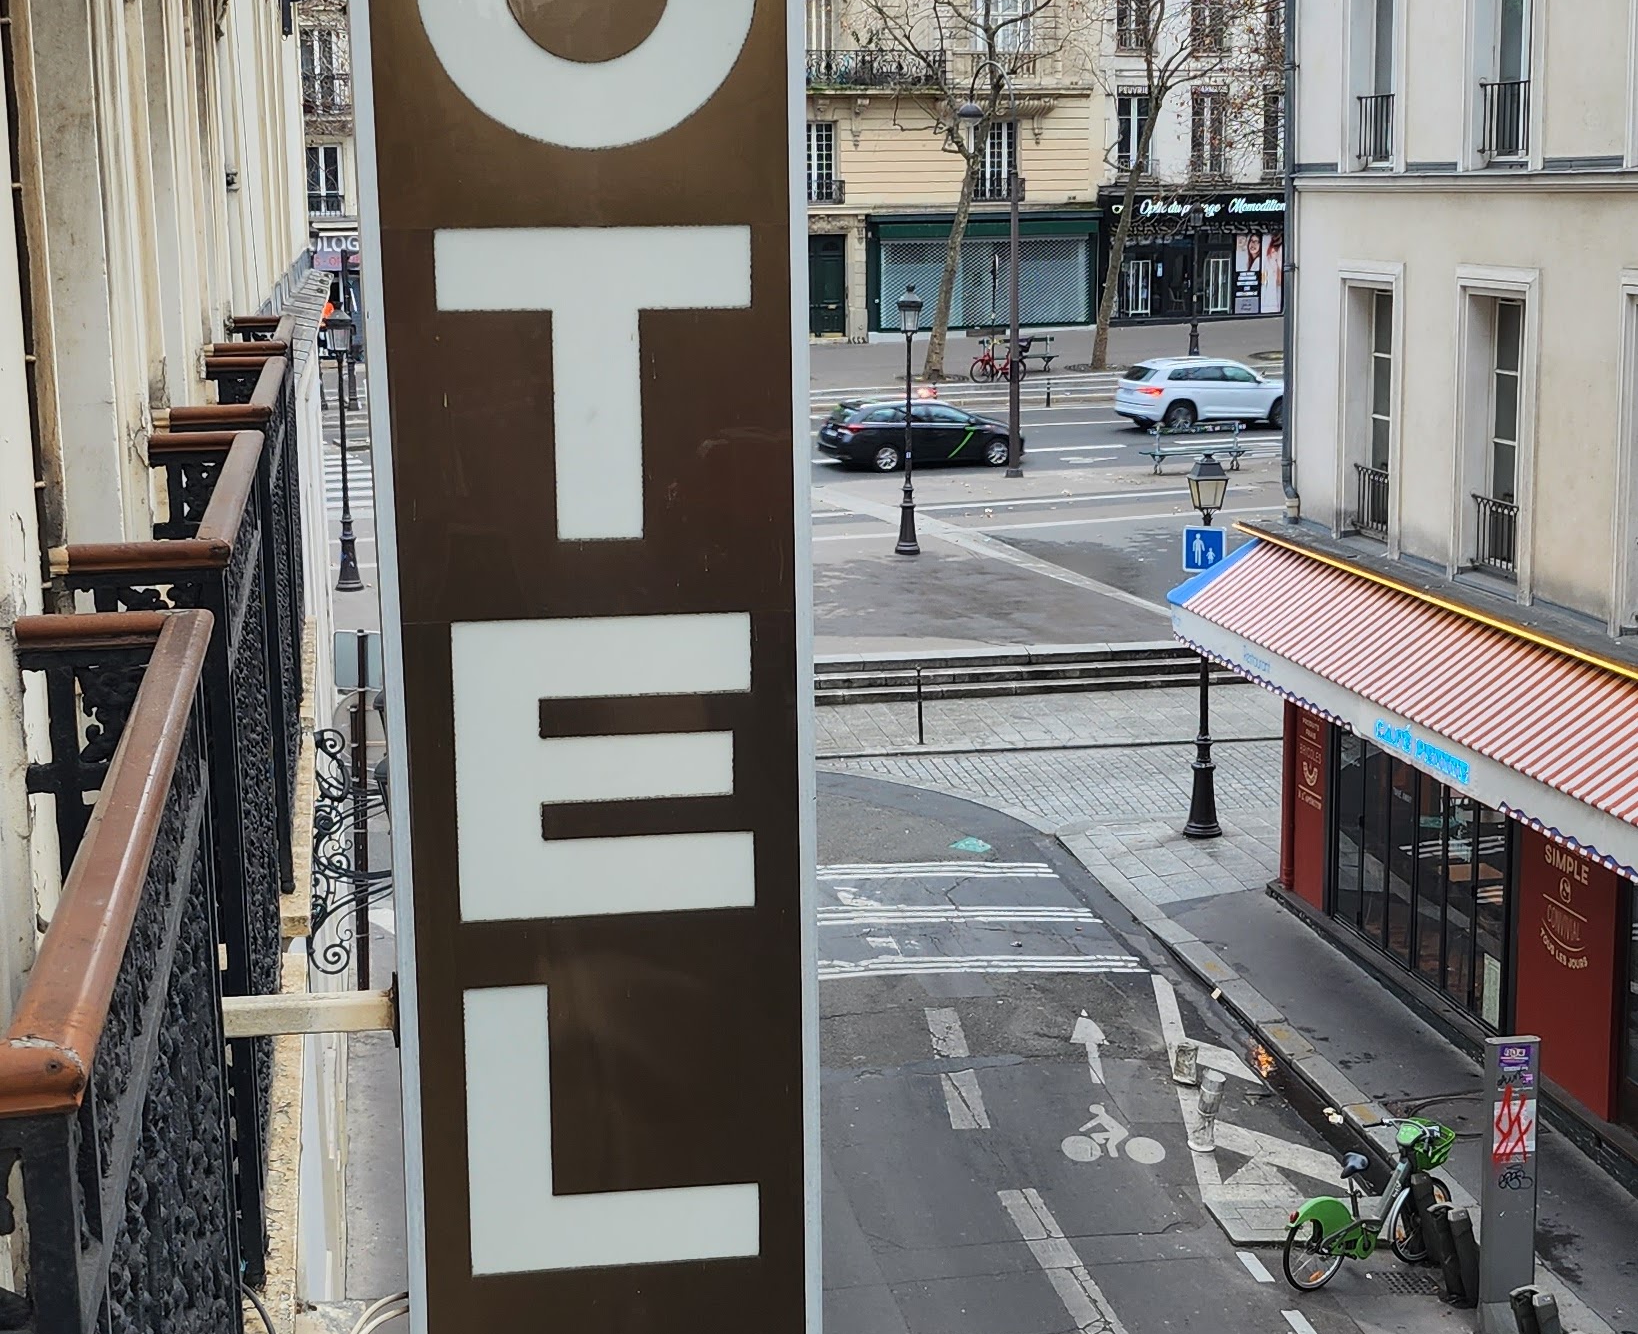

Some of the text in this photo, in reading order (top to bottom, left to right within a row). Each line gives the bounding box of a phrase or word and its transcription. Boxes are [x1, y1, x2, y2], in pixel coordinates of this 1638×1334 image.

[1544, 844, 1590, 886] SIMPLE
[1539, 927, 1588, 970] TOUS LES JOURS
